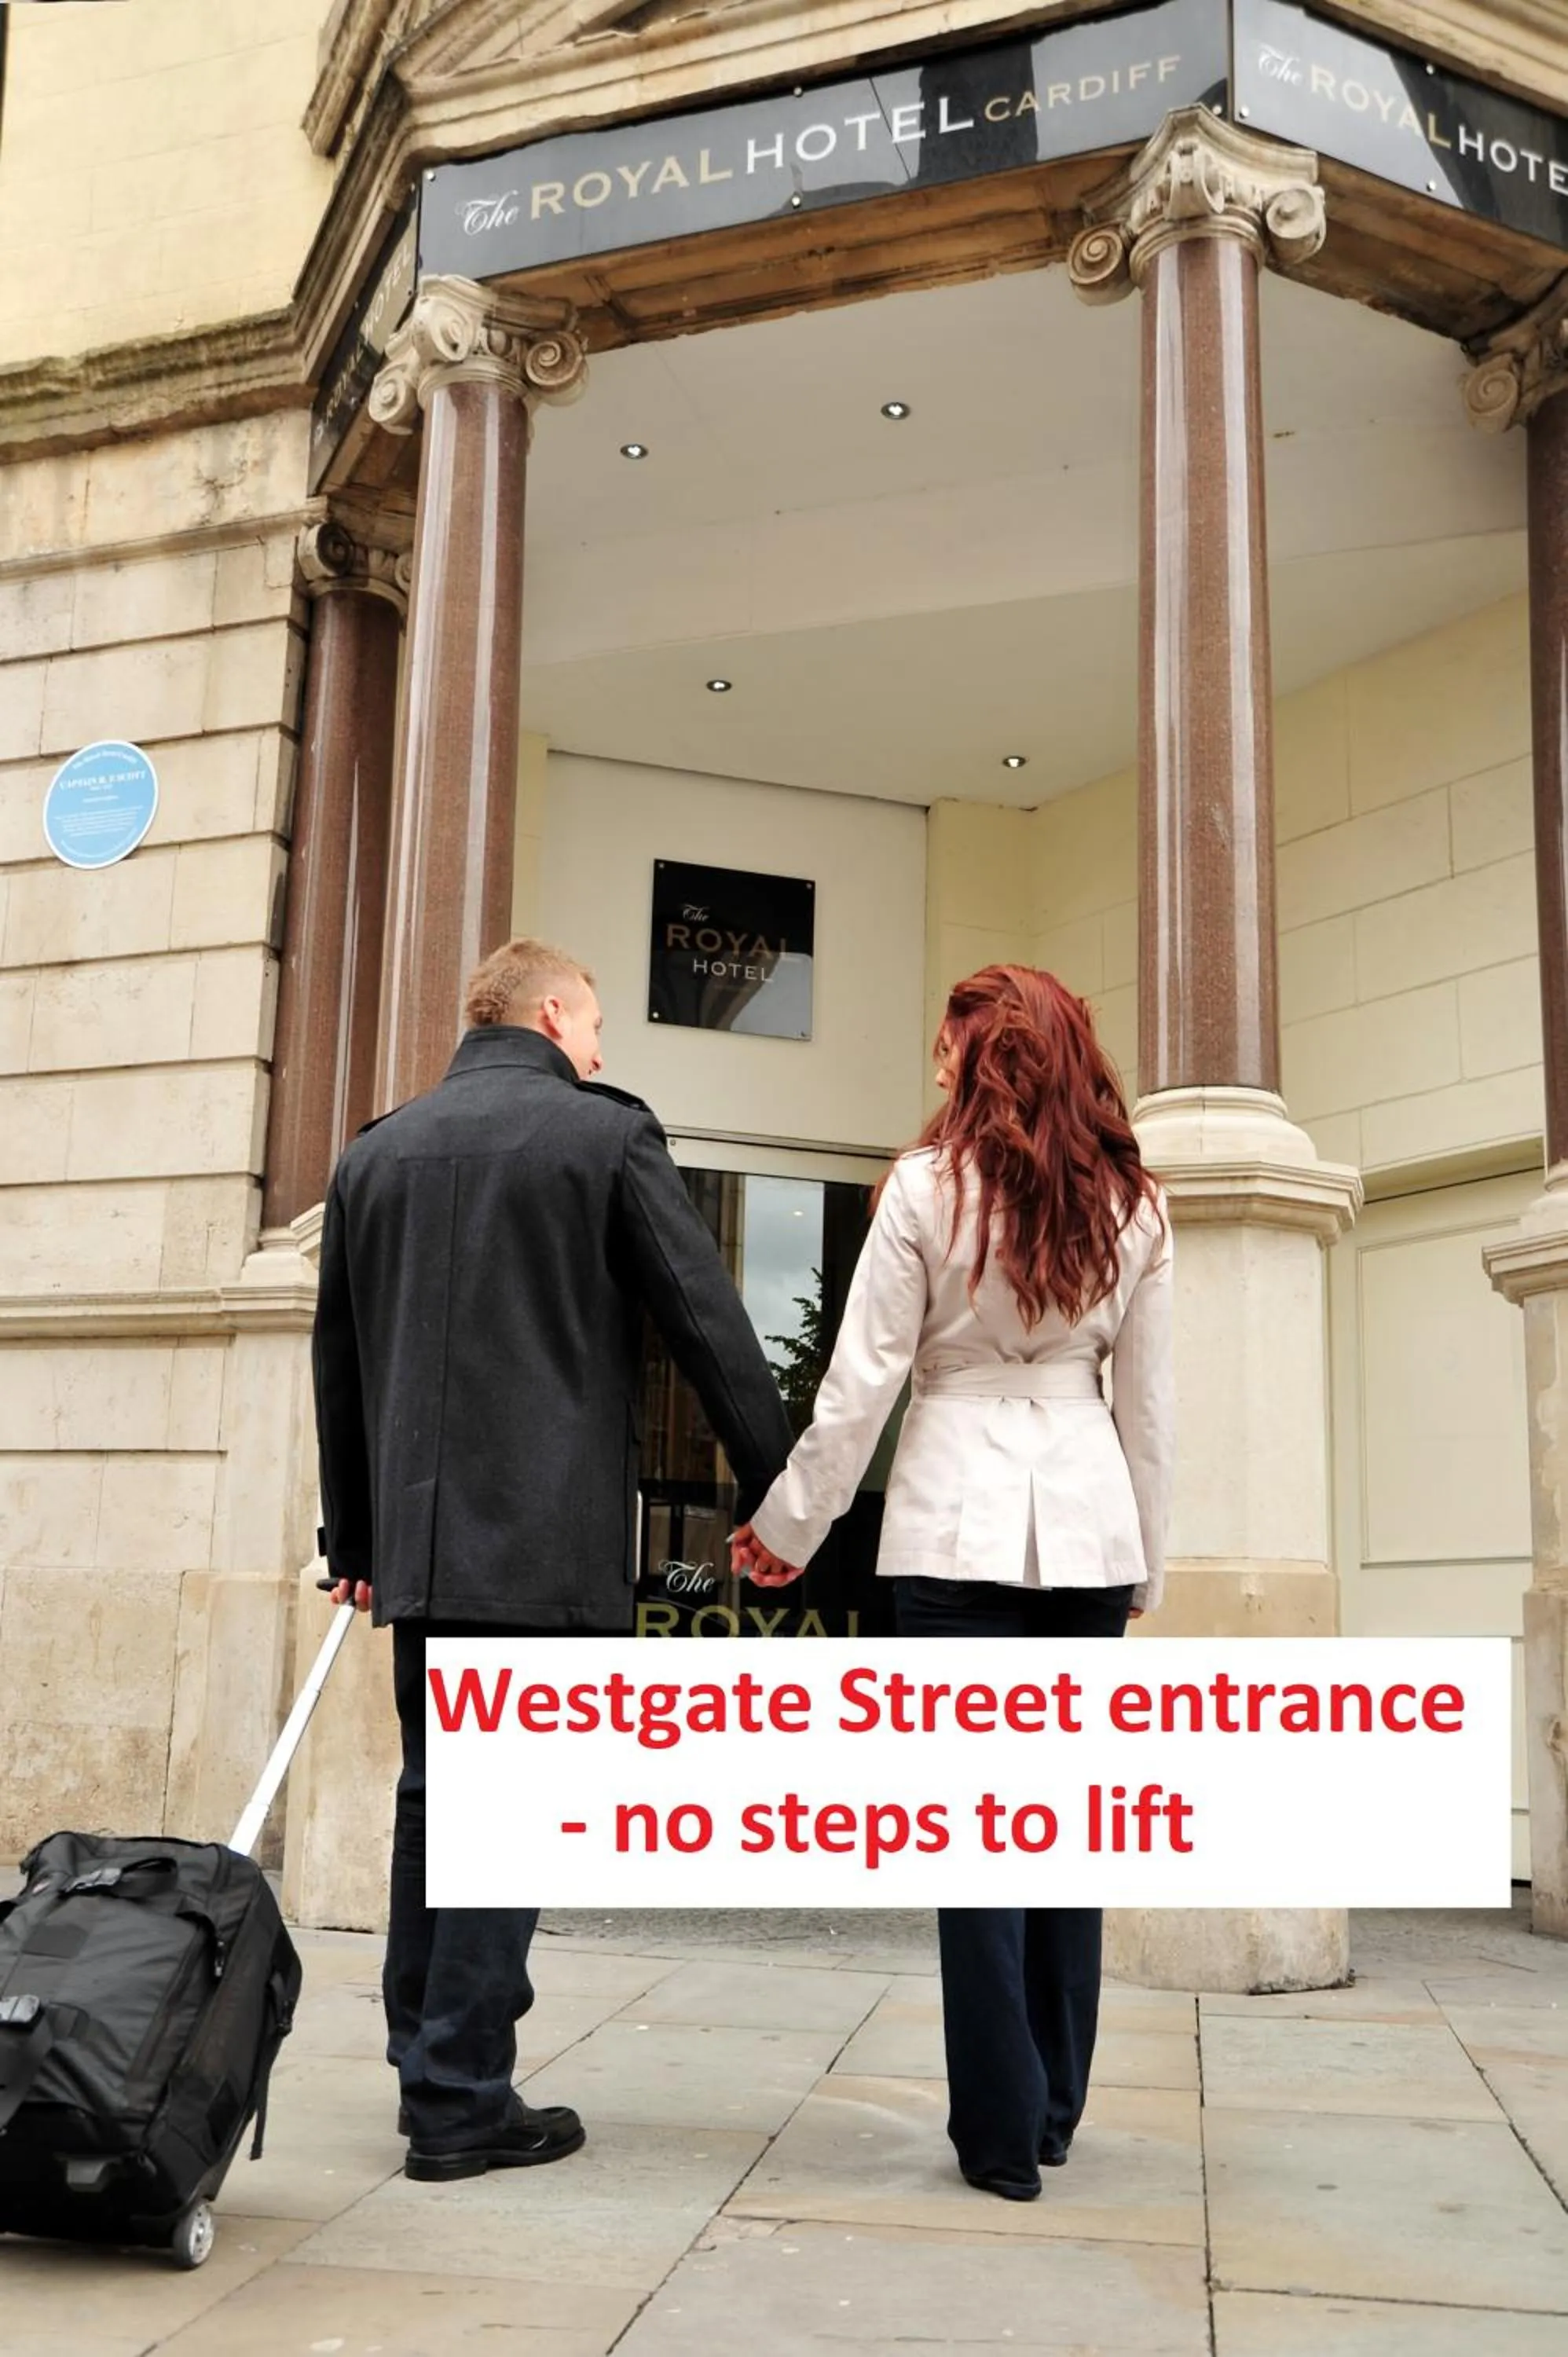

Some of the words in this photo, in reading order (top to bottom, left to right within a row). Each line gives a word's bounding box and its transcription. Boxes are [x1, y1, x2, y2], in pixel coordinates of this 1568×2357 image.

[1257, 44, 1303, 86] The
[1310, 64, 1451, 148] ROYAL
[455, 189, 518, 236] The
[531, 148, 733, 220] ROYAL
[746, 97, 974, 174] HOTEL
[984, 56, 1180, 122] CARDIFF
[680, 904, 710, 922] The
[666, 922, 803, 964] ROYAL
[692, 958, 775, 983] HOTEL
[658, 1560, 716, 1593] The
